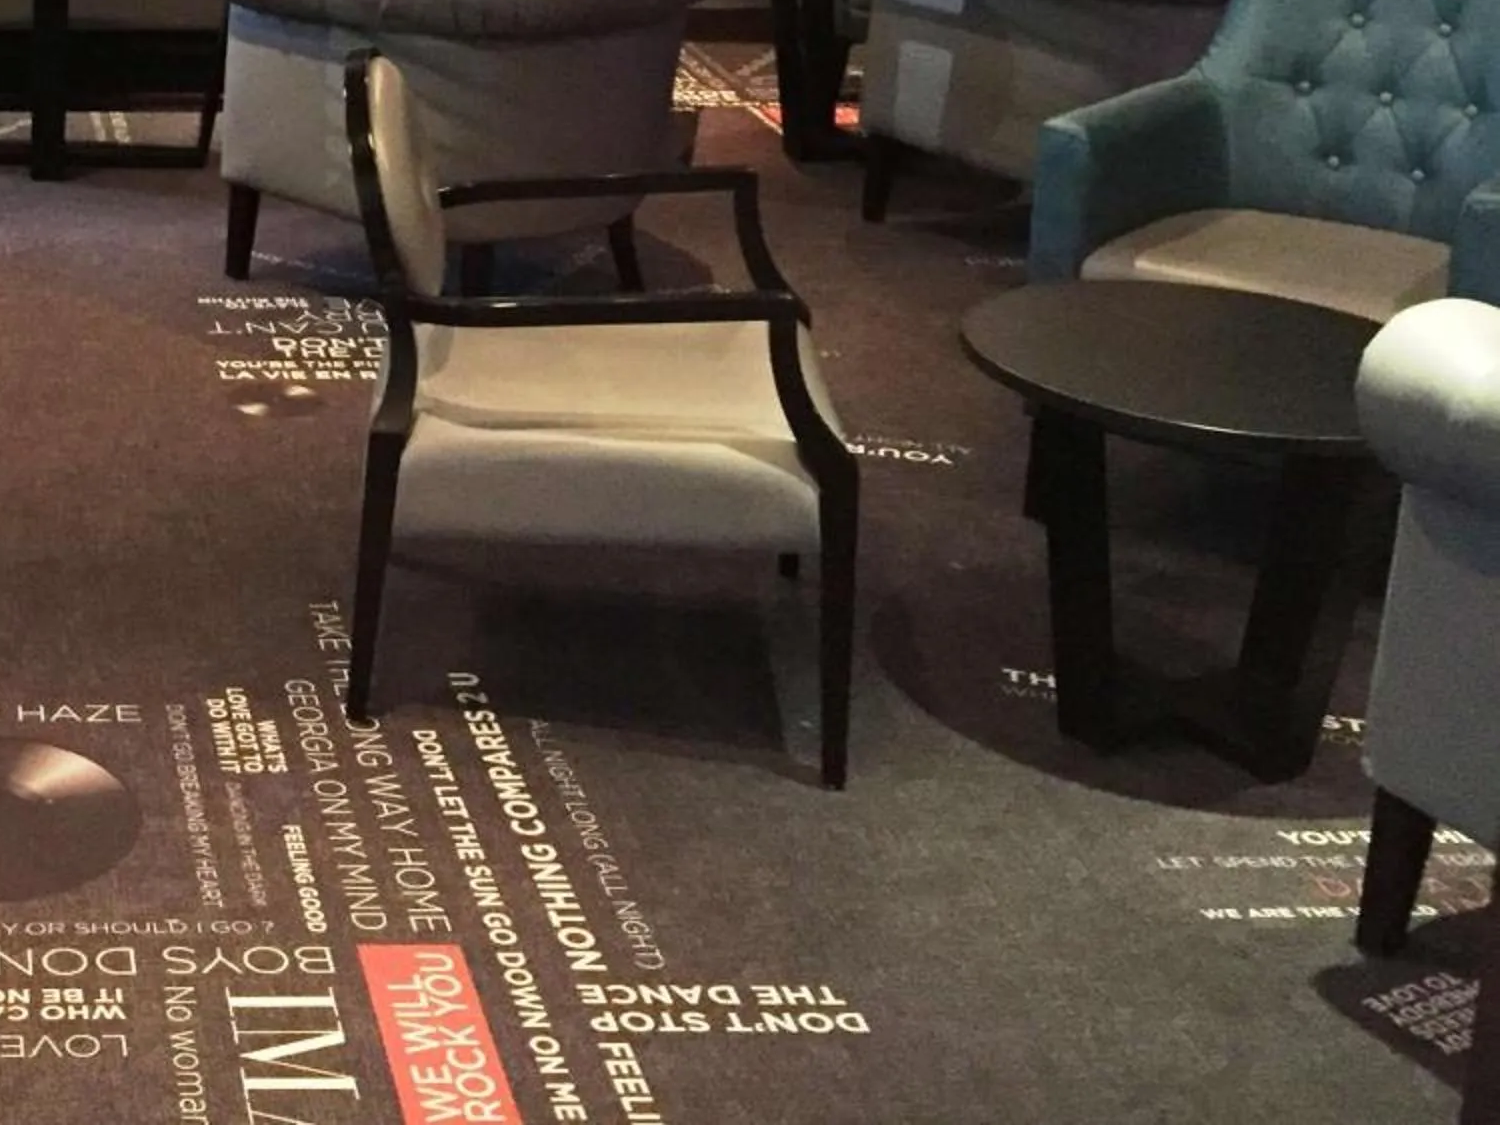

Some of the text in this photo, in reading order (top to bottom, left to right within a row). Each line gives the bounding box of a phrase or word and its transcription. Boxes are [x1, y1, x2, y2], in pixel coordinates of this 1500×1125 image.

[207, 320, 343, 336] CAN'T
[271, 336, 388, 350] DON'T
[215, 359, 347, 369] YOU'RE THE
[282, 346, 352, 359] THE
[219, 370, 352, 380] LA VIE EN
[16, 703, 143, 724] HAZE
[225, 686, 265, 774] LOVE GOT TO
[205, 697, 242, 775] DO WITH IT
[309, 600, 453, 933] TAKE WAY HOME
[284, 677, 388, 931] GEORGIA ON MY MIND
[434, 785, 470, 819] LET
[176, 763, 223, 909] BREAKING MY HEART
[447, 671, 608, 972] NOTHING COMPARES 2 U
[449, 821, 486, 862] THE
[529, 718, 667, 971] ALL NIGHT LONG (ALL NIGHT)
[281, 823, 328, 935] FEELING GOOD
[464, 864, 505, 908] SUN
[25, 921, 63, 936] OR
[73, 919, 188, 935] SHOULD
[211, 920, 254, 935] GO
[482, 912, 518, 946] GO
[1199, 905, 1350, 921] WE ARE THE
[161, 945, 336, 975] BOYS
[42, 987, 83, 1004] BE
[93, 987, 125, 1004] IT
[496, 950, 552, 1029] DOWN
[575, 984, 848, 1007] THE DANCE
[39, 1004, 128, 1022] WHO
[590, 1010, 871, 1035] DON'T STOP
[0, 1034, 131, 1060] LOVE
[224, 985, 362, 1125] IM
[386, 972, 463, 1124] WE WILL
[413, 952, 509, 1123] ROCK YOU
[528, 1035, 570, 1076] ON
[544, 1081, 589, 1122] ME
[596, 1041, 666, 1125] FEELI
